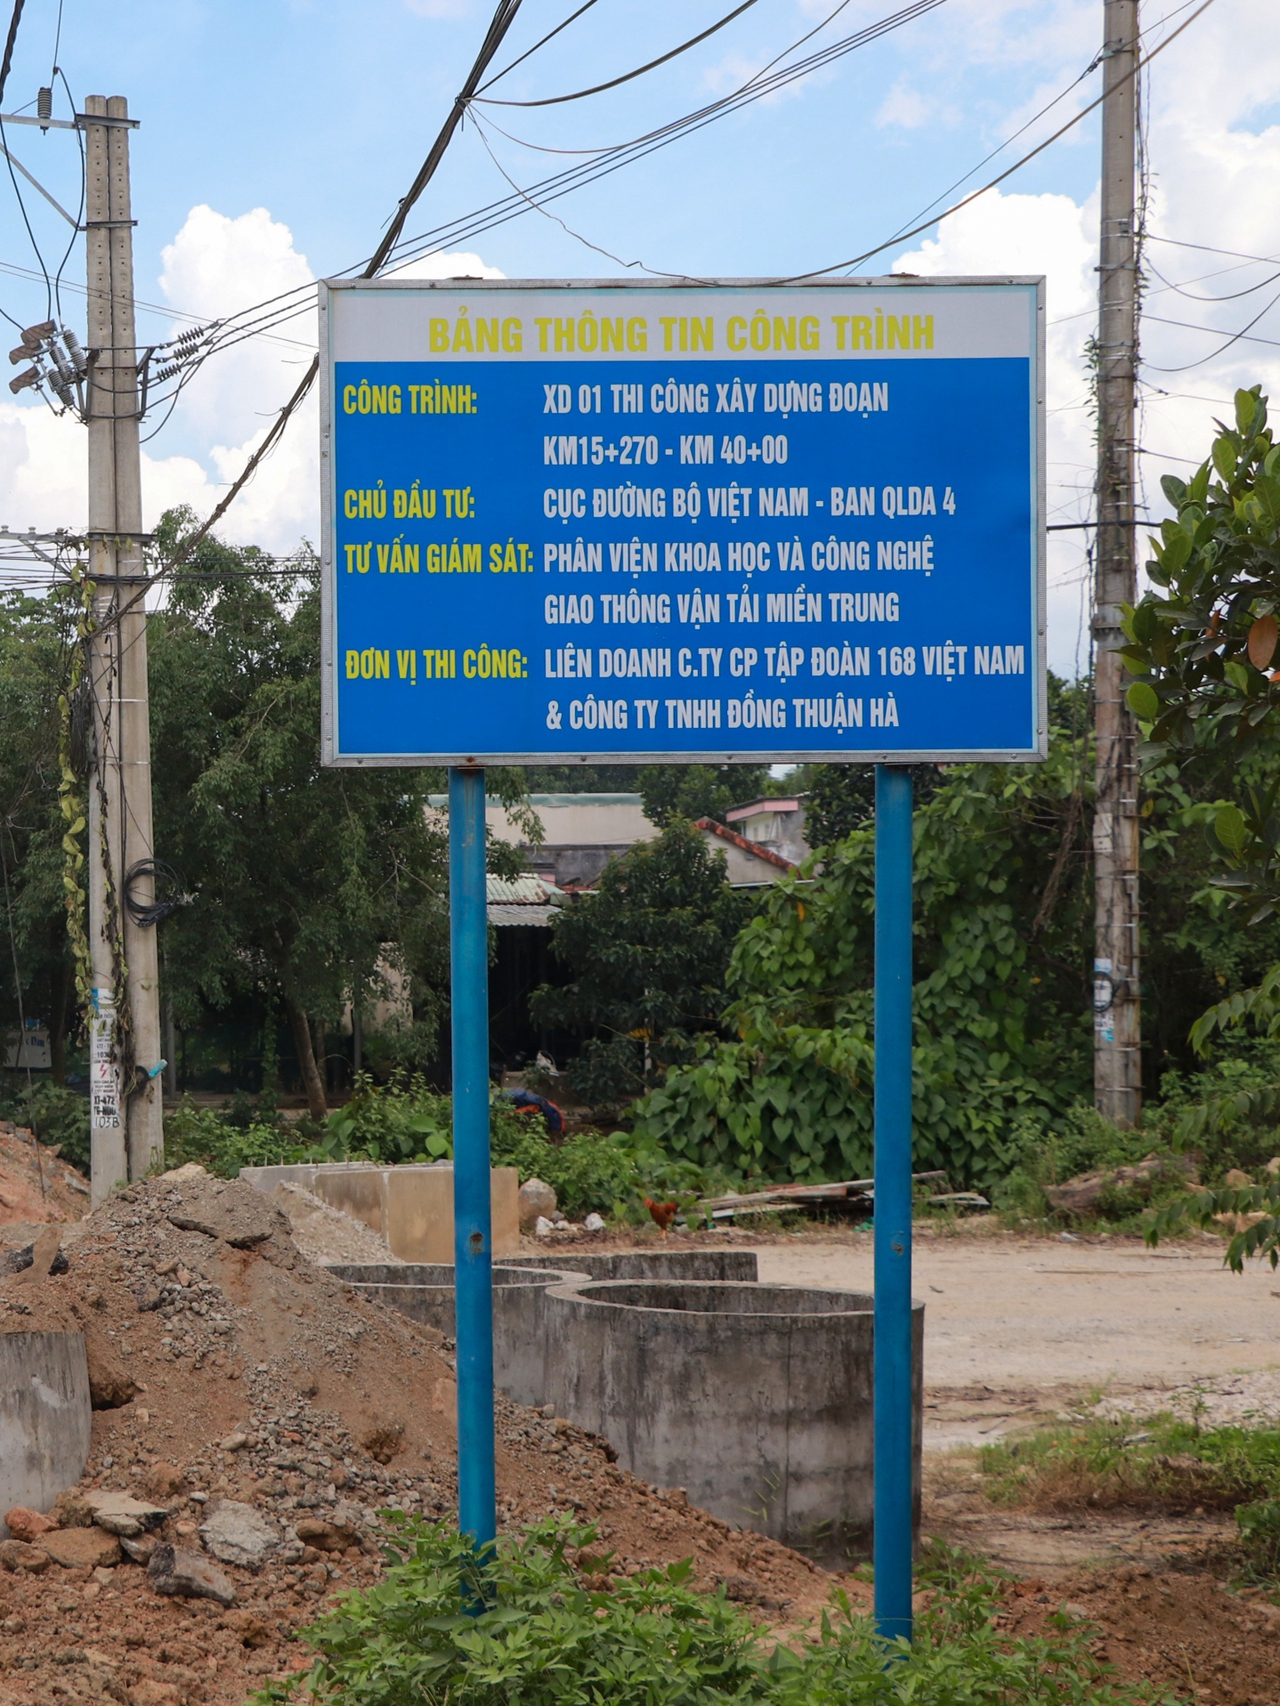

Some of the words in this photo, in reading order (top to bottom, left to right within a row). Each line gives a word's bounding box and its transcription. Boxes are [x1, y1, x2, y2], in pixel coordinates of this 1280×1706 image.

[430, 306, 522, 352] BẢNG
[535, 310, 647, 352] THÔNG
[660, 317, 713, 351] TIN
[727, 309, 819, 351] CÔNG
[832, 308, 933, 350] TRÌNH
[344, 379, 401, 414] CÔNG
[408, 379, 476, 413] TRÌNH:
[544, 385, 571, 413] XD
[579, 385, 600, 413] 01
[611, 385, 643, 413] THI
[651, 378, 708, 413] CÔNG
[716, 378, 756, 412] XÂY
[764, 381, 822, 418] DỰNG
[829, 383, 888, 418] ĐOẠN
[544, 436, 658, 464] KM15+270
[681, 436, 713, 464] KM
[721, 435, 787, 464] 40+00
[345, 480, 386, 518] CHỦ
[393, 480, 436, 518] ĐẦU
[443, 487, 474, 518] TƯ:
[544, 489, 585, 524] CỤC
[593, 481, 665, 517] ĐƯỜNG
[673, 482, 700, 523] BỘ
[708, 482, 752, 523] VIỆT
[759, 488, 808, 516] NAM
[831, 487, 874, 515] BAN
[883, 486, 936, 519] QLDA
[943, 487, 955, 514] 4
[344, 542, 372, 573] TƯ
[377, 534, 419, 572] VẤN
[427, 538, 481, 573] GIÁM
[490, 538, 533, 572] SÁT:
[544, 537, 602, 572] PHÂN
[609, 537, 657, 578] VIỆN
[665, 543, 721, 571] KHOA
[728, 542, 770, 577] HỌC
[777, 536, 804, 570] VÀ
[812, 536, 869, 570] CÔNG
[878, 535, 934, 576] NGHỆ
[545, 595, 593, 624] GIAO
[601, 588, 670, 623] THÔNG
[677, 588, 719, 629] VẬN
[727, 584, 759, 622] TẢI
[767, 584, 821, 622] MIỀN
[829, 593, 899, 622] TRUNG
[346, 647, 389, 679] ĐƠN
[397, 650, 416, 685] VỊ
[423, 650, 455, 678] THI
[464, 643, 527, 678] CÔNG:
[546, 643, 591, 677] LIÊN
[599, 648, 671, 677] DOANH
[679, 648, 722, 677] C.TY
[730, 648, 757, 676] CP
[765, 642, 804, 682] TẬP
[811, 641, 869, 676] ĐOÀN
[878, 647, 915, 675] 168
[923, 640, 967, 681] VIỆT
[975, 646, 1024, 674] NAM
[547, 701, 561, 729] &
[570, 694, 627, 729] CÔNG
[634, 700, 658, 728] TY
[665, 700, 720, 728] TNHH
[727, 689, 786, 728] ĐỒNG
[793, 692, 862, 734] THUẬN
[871, 692, 899, 726] HÀ
[95, 1116, 120, 1129] 103B
